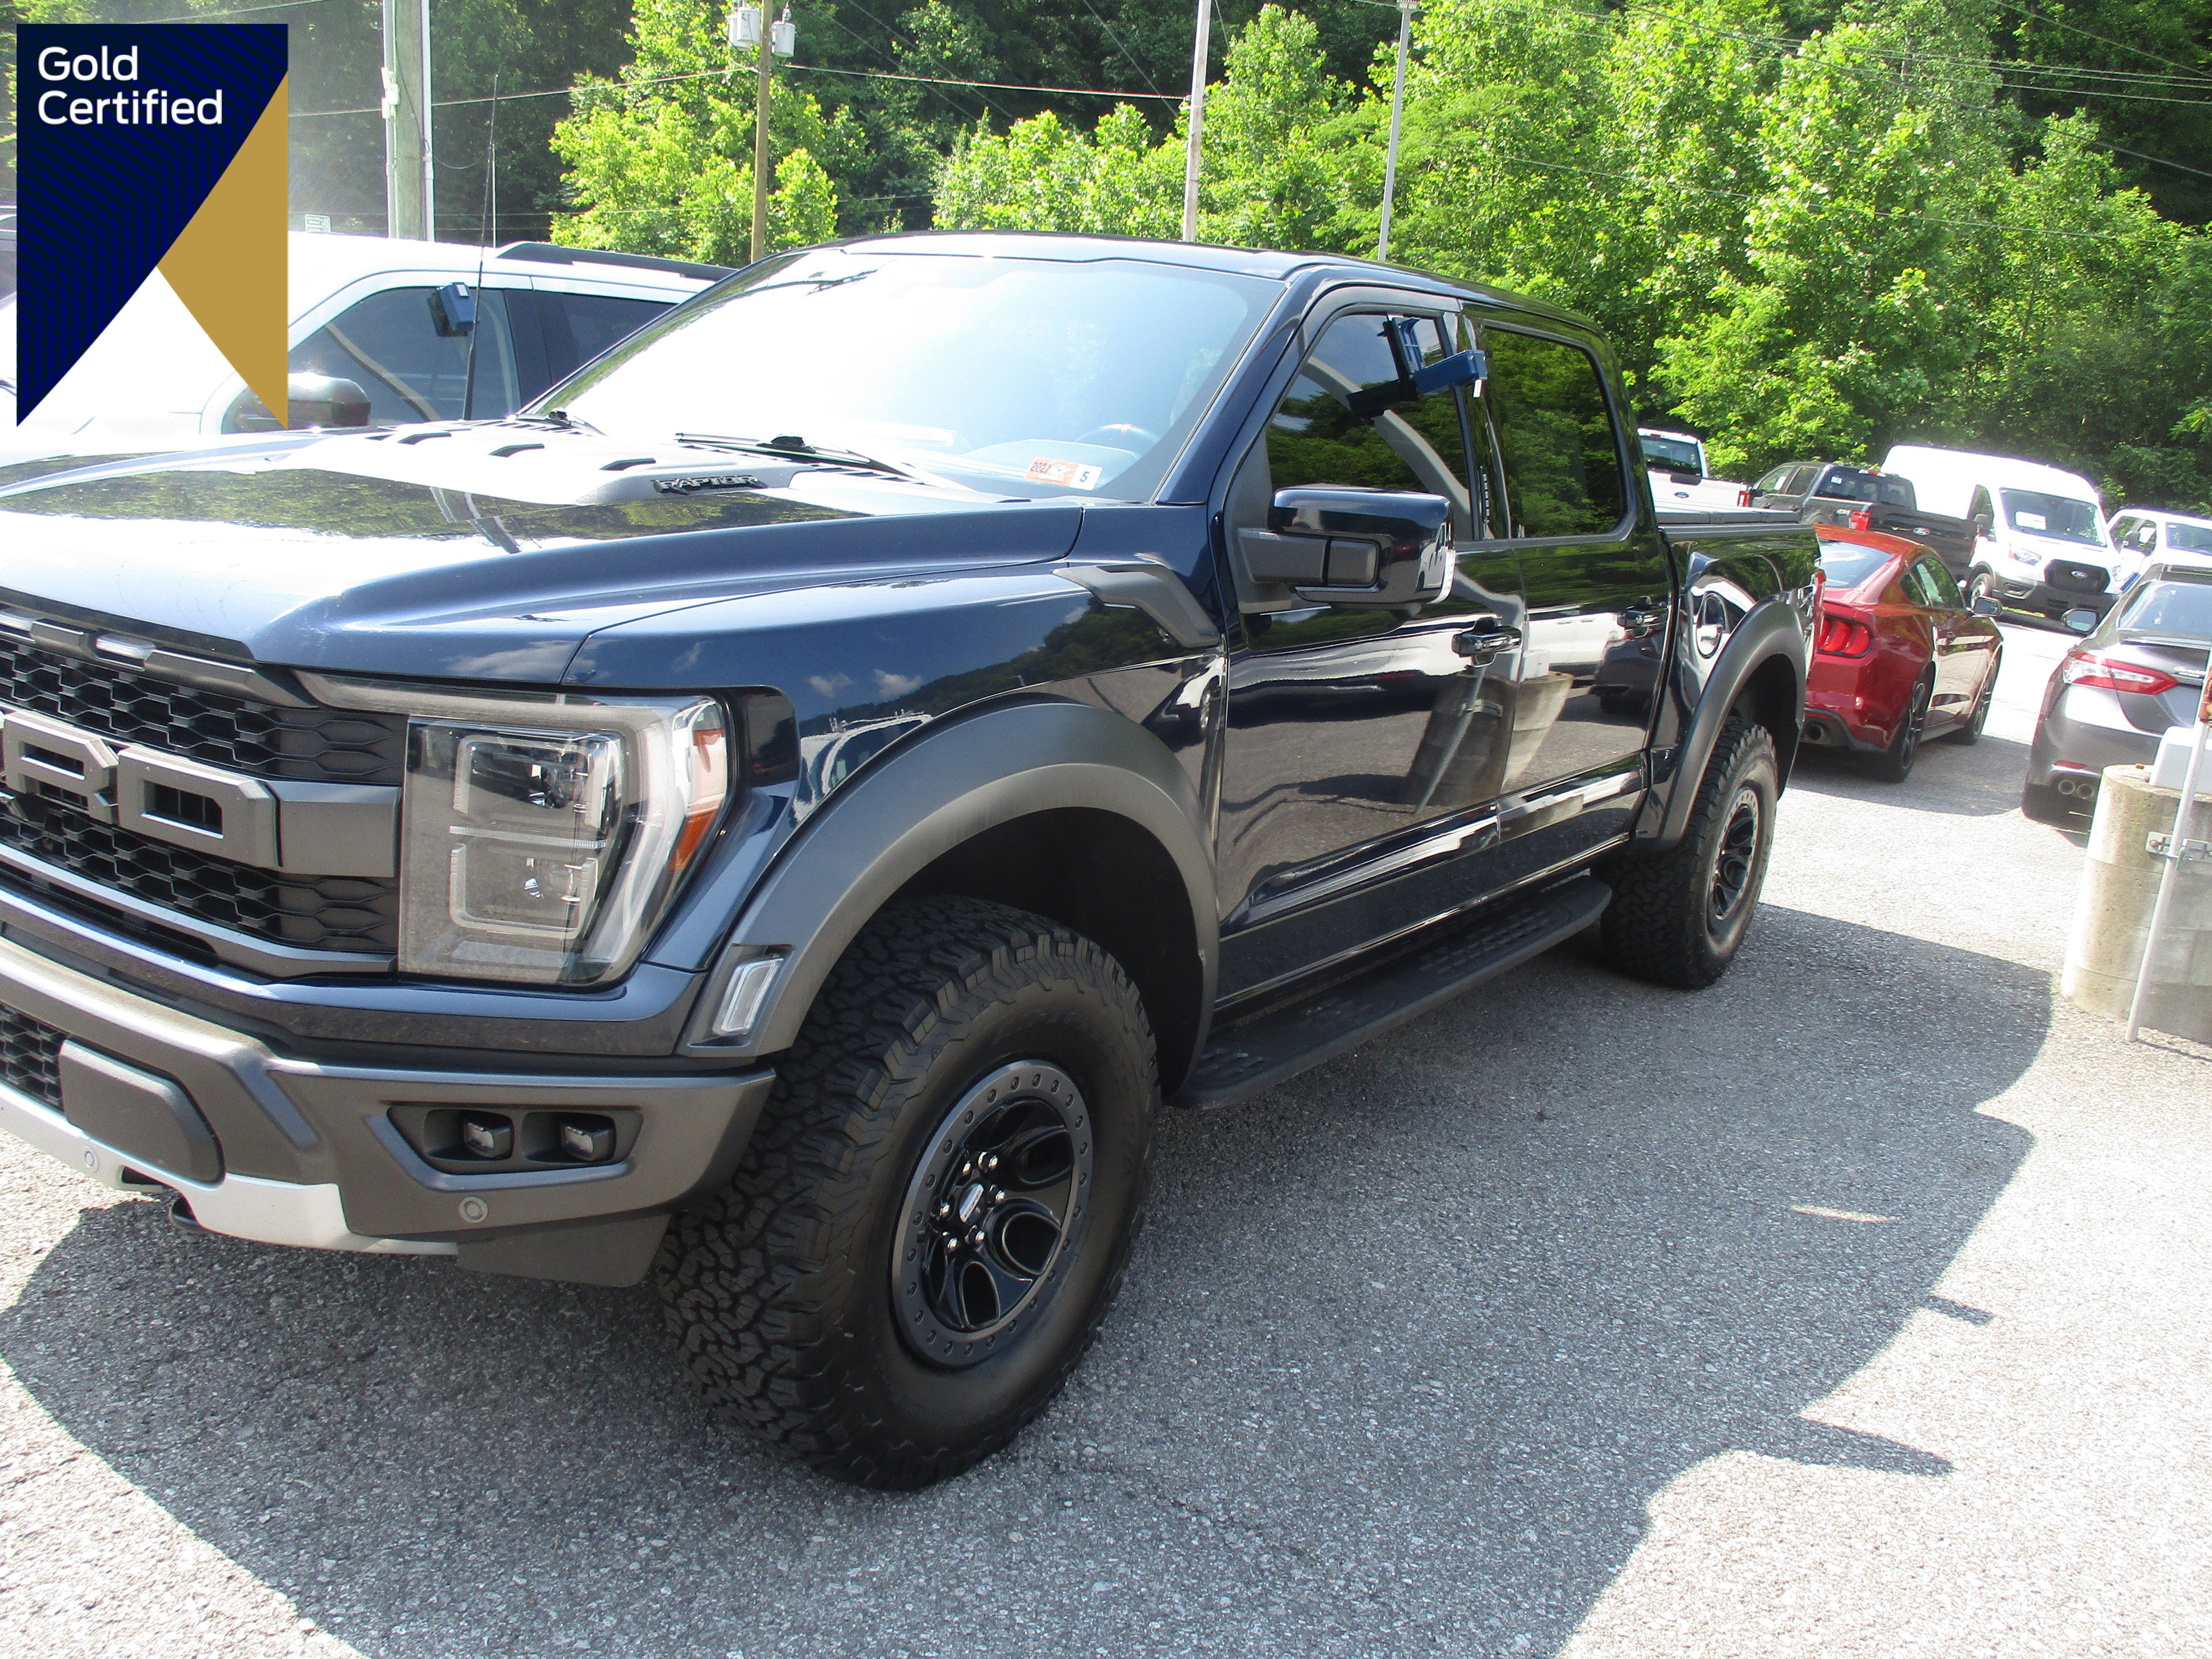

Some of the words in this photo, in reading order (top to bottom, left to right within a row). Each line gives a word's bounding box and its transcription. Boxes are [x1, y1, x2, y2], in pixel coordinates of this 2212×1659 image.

[653, 474, 765, 495] RAPTOR
[1080, 471, 1090, 483] 5
[0, 710, 281, 867] RD
